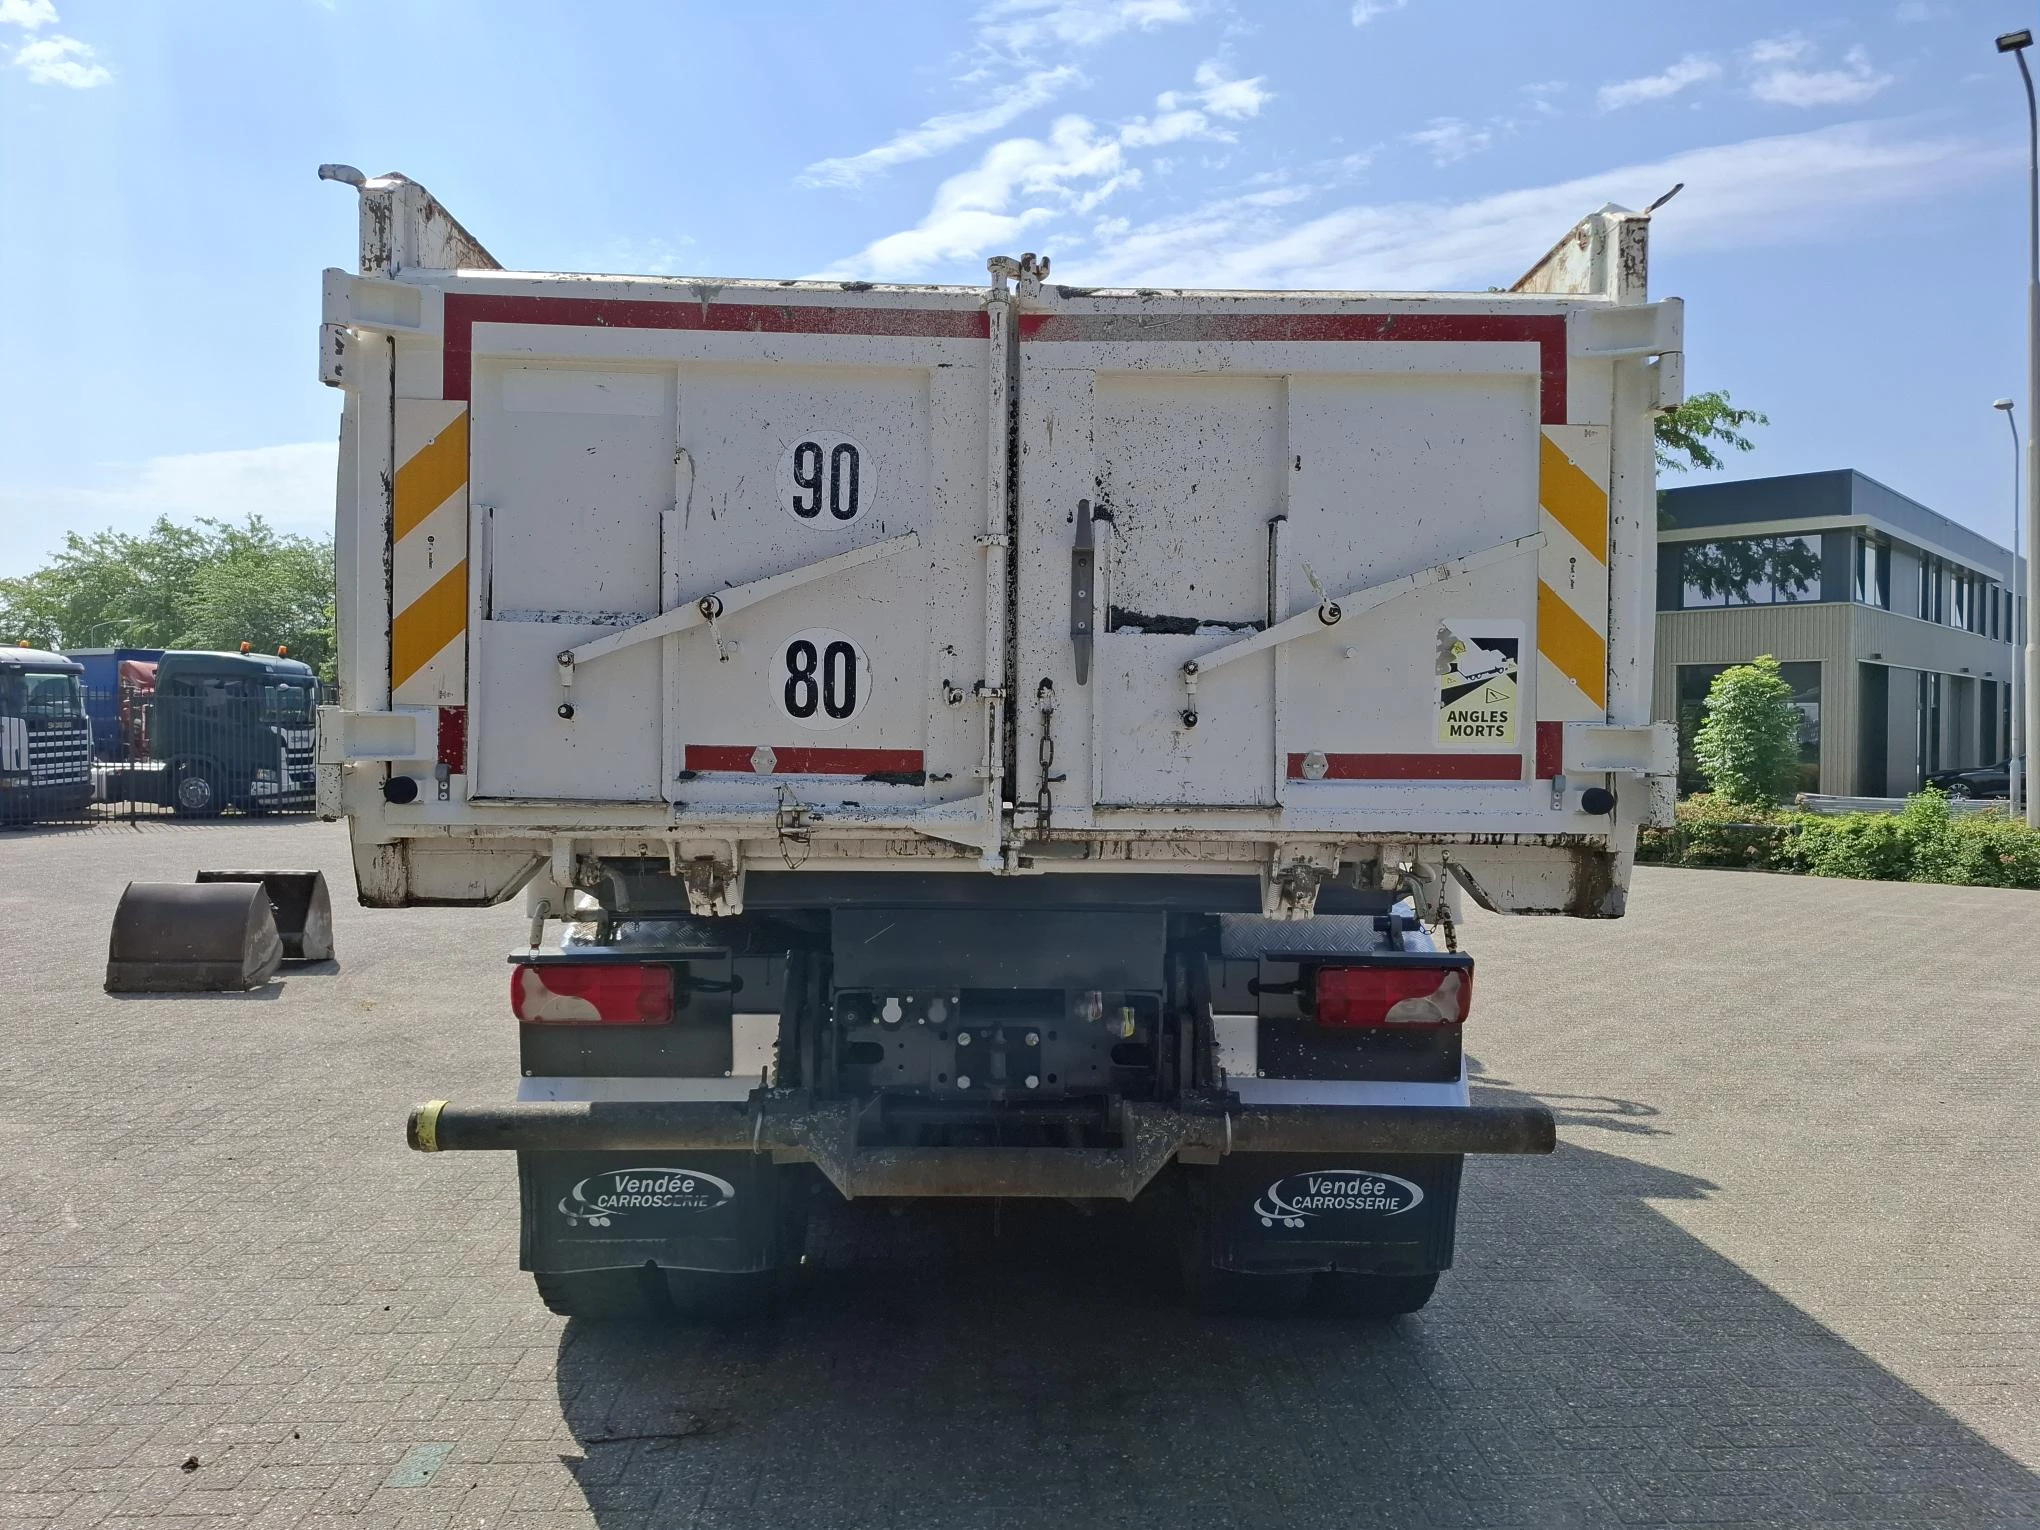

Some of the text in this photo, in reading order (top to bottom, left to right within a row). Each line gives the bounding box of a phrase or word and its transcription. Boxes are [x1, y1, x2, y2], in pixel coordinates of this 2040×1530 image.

[793, 441, 860, 520] 90
[784, 639, 857, 719] 80
[1447, 710, 1508, 723] ANGLES
[1449, 724, 1504, 737] MORTS
[615, 1175, 694, 1193] Vendée
[1308, 1177, 1386, 1195] Vendée
[1292, 1197, 1400, 1210] CARROSSERIE
